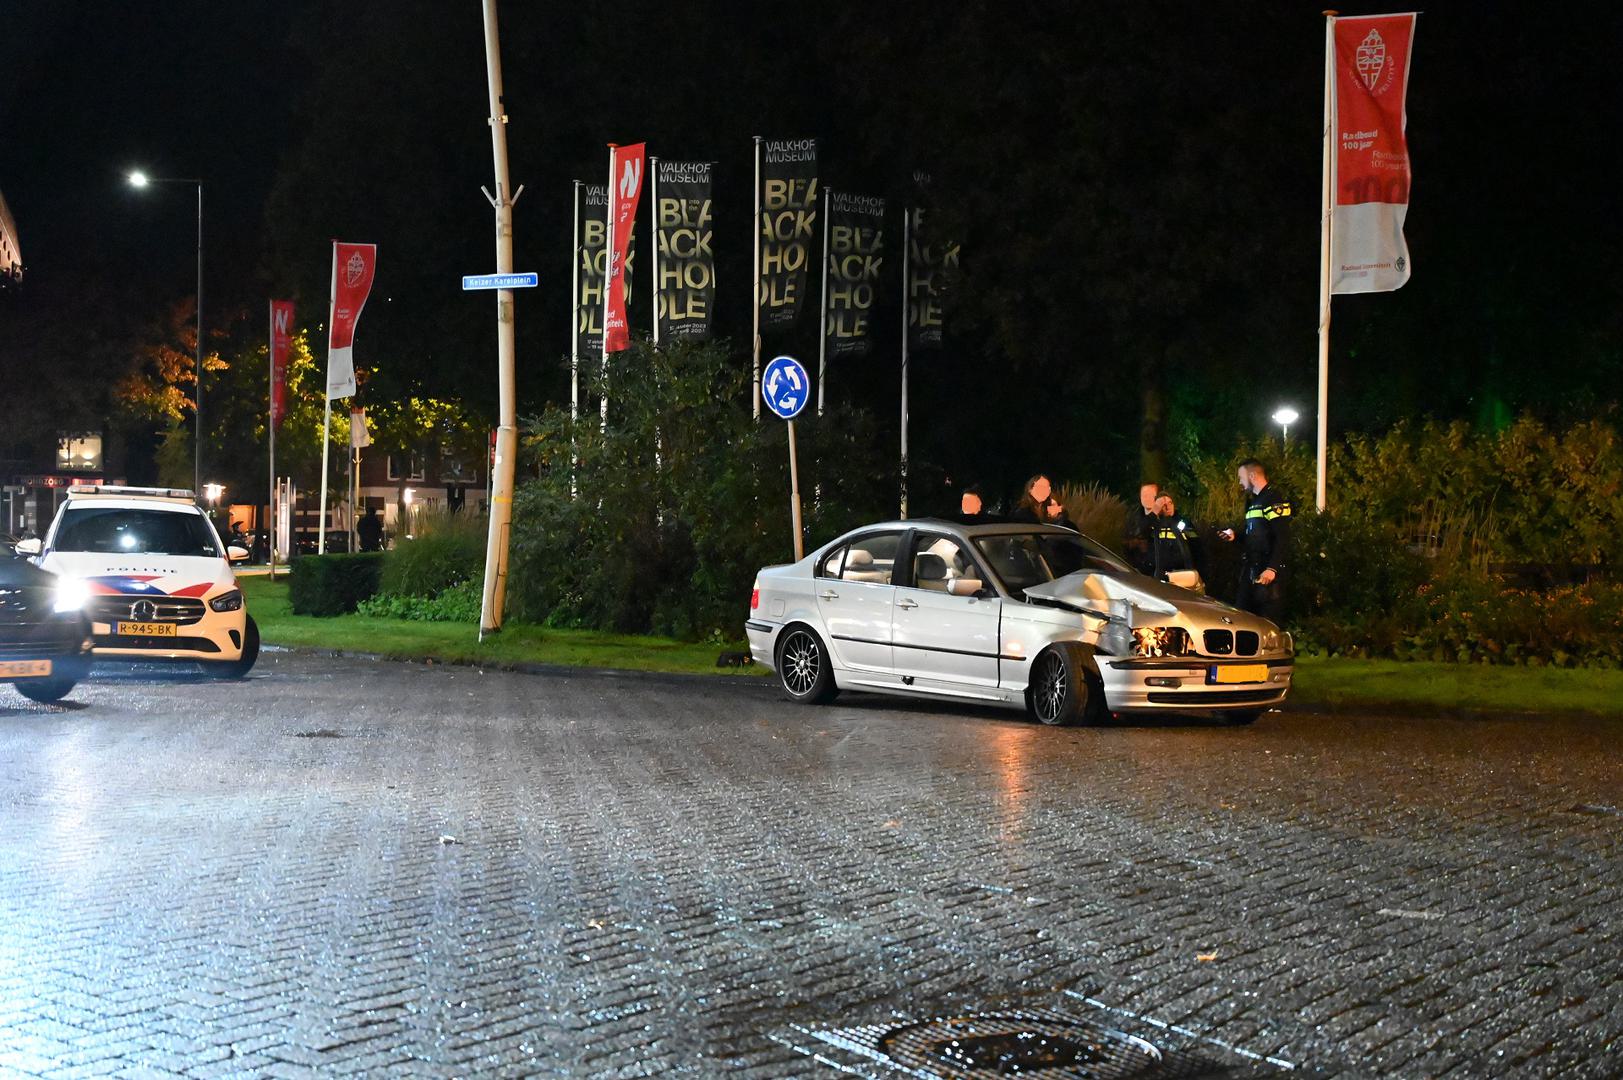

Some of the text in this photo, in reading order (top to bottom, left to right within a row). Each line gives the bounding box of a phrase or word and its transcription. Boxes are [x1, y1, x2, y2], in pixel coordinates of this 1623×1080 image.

[1342, 129, 1378, 141] Radboud
[765, 139, 816, 152] VALKHOF
[1342, 140, 1359, 150] 100
[765, 151, 816, 163] MUSEUM
[659, 162, 712, 174] VALKHOF
[659, 173, 710, 184] MUSEUM
[832, 193, 886, 207] VALKHOF
[832, 203, 884, 217] MUSEUM
[469, 278, 493, 286] Keizer
[120, 623, 173, 635] R-945-BK
